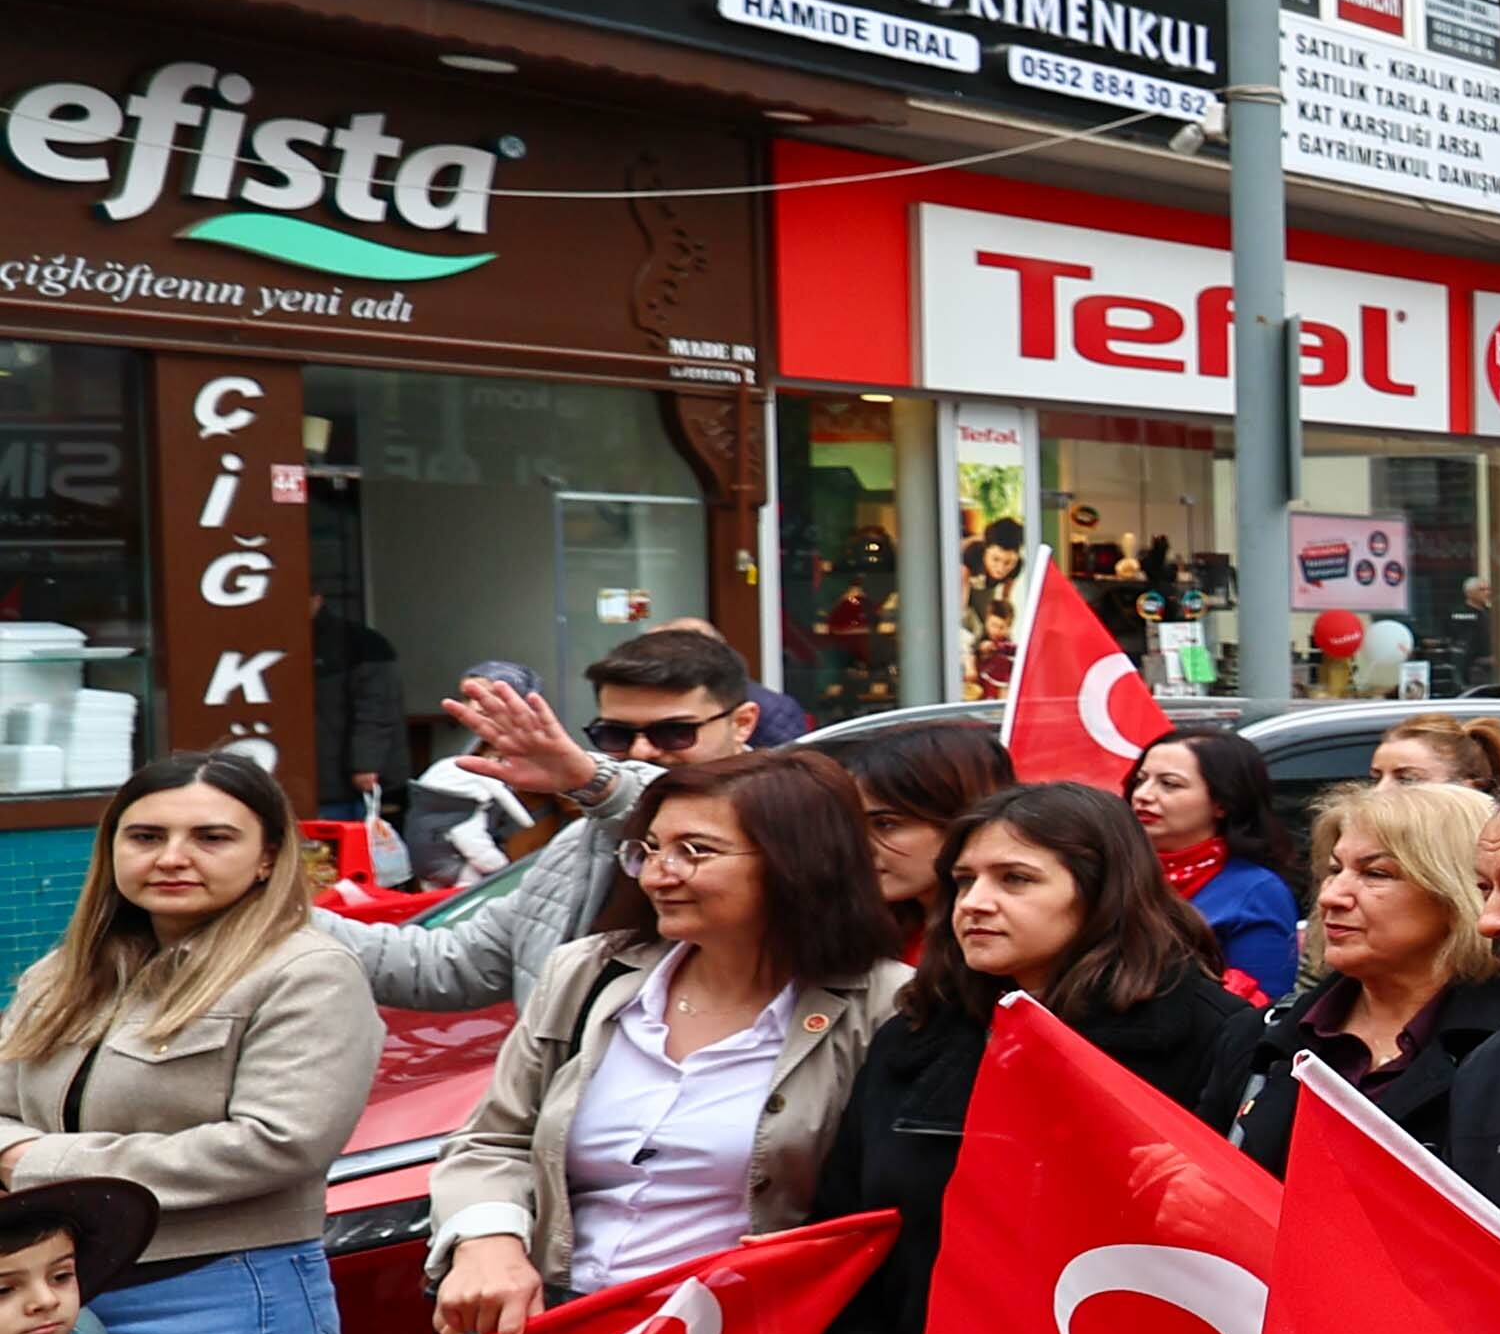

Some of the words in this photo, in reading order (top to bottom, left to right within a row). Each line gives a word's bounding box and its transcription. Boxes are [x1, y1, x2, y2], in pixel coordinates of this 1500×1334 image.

[882, 21, 960, 64] URAL
[1295, 33, 1368, 72] SATILIK
[1021, 52, 1084, 90] 0552
[1091, 68, 1136, 103] 884
[1145, 82, 1174, 110] 30
[1296, 66, 1369, 106] SATILIK
[1374, 86, 1431, 118] TARLA
[1436, 101, 1450, 121] &
[5, 63, 498, 236] efista
[1296, 100, 1334, 127] KAT
[1437, 130, 1484, 161] ARSA
[252, 284, 345, 318] yeni
[349, 289, 414, 323] adı
[976, 250, 1417, 398] Tefal
[957, 424, 1020, 449] Tefal
